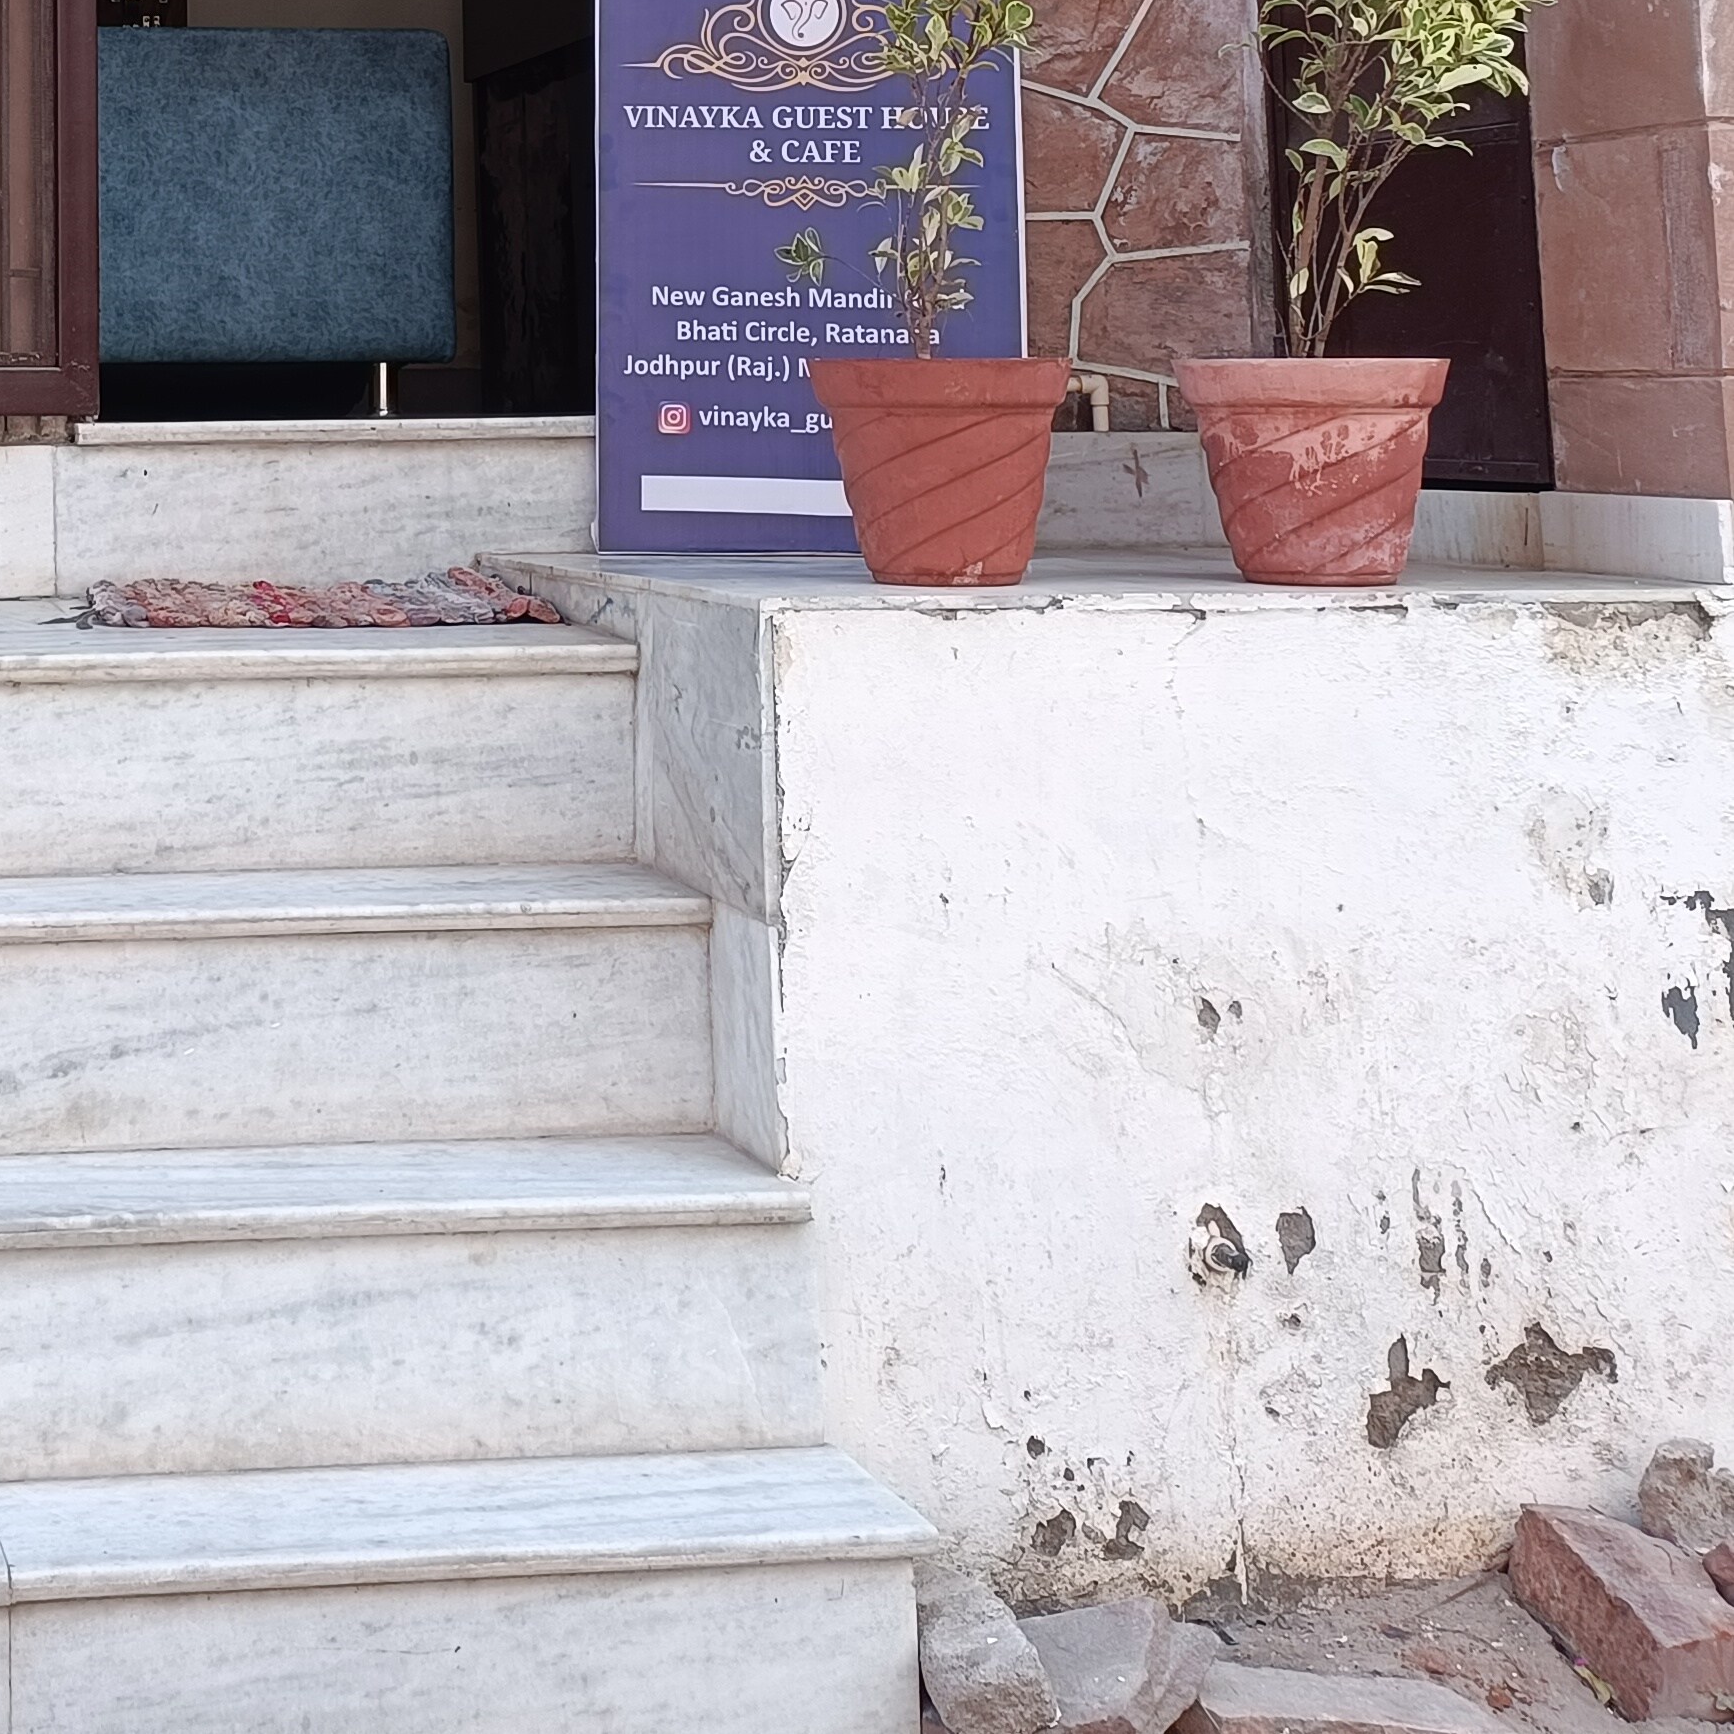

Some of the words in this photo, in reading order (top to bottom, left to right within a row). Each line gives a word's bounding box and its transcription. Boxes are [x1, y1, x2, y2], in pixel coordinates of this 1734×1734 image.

[623, 105, 764, 129] VINAYKA
[772, 105, 873, 129] GUEST
[880, 105, 990, 130] HOUE
[749, 139, 773, 163] &
[781, 139, 861, 163] CAFE
[652, 285, 706, 306] New
[712, 286, 801, 307] Ganesh
[677, 319, 738, 341] Bhati
[745, 321, 818, 347] Circle,
[825, 323, 940, 345] Ratanaa
[623, 353, 721, 380] Jodhpur
[727, 354, 790, 382] (Raj.)
